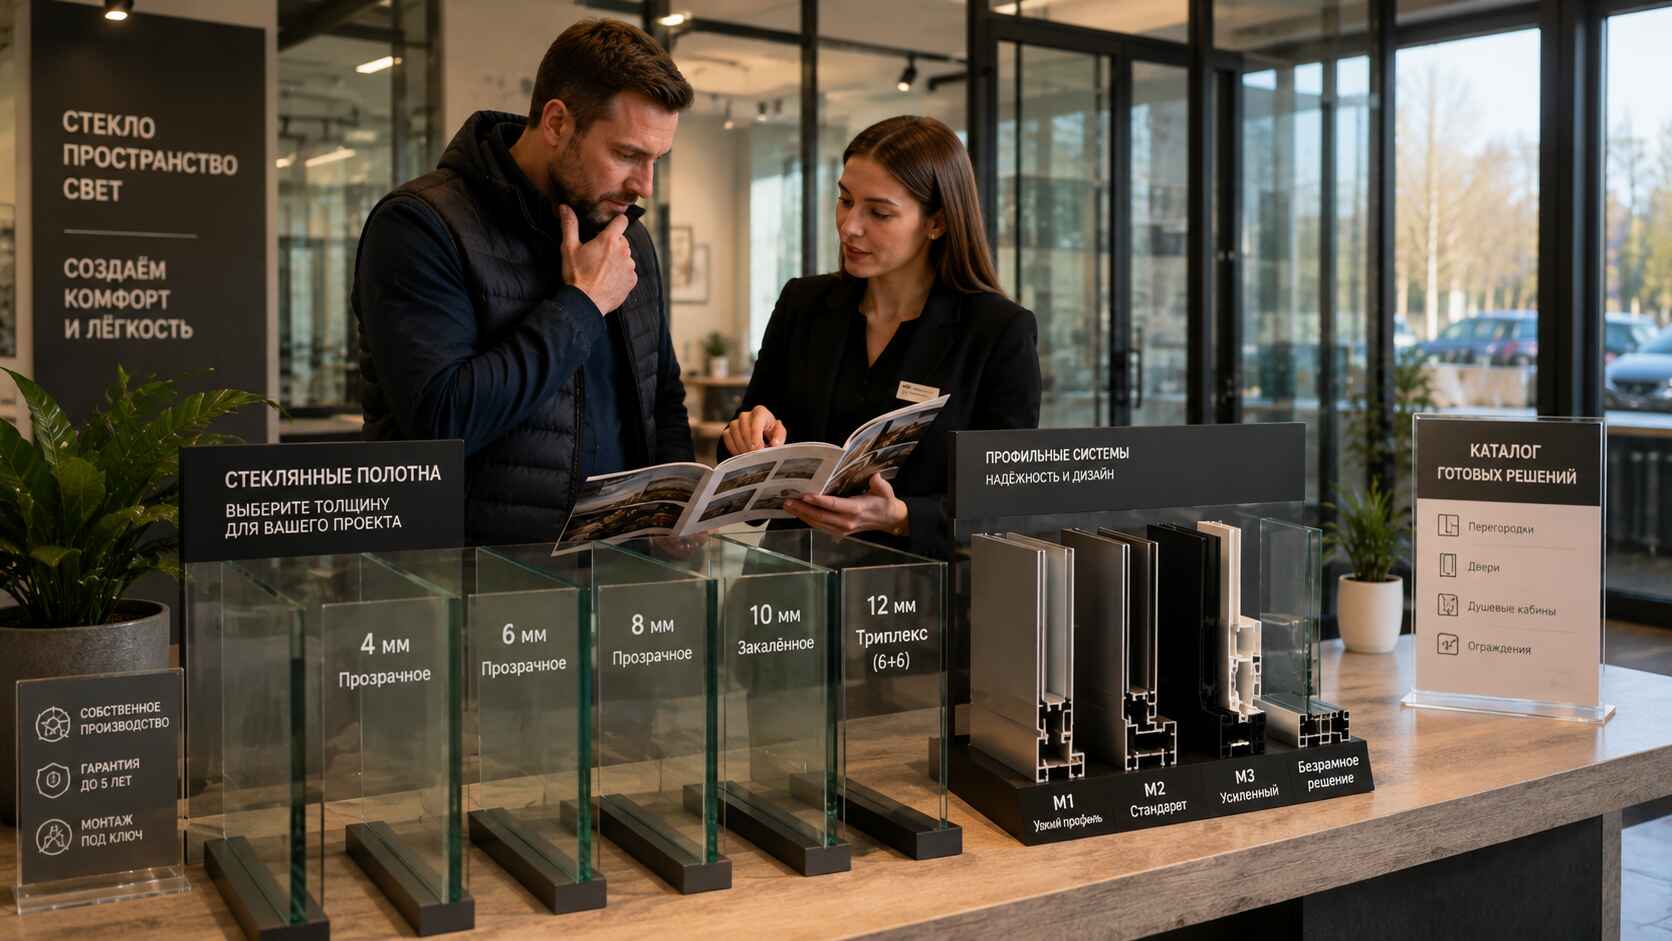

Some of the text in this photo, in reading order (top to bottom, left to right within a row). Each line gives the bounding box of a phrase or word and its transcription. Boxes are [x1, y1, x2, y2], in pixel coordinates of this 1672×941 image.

[62, 110, 156, 139] СТЕКЛО
[63, 144, 239, 176] ПРОСТРАНСТВО
[63, 177, 123, 202] СВЕТ
[64, 256, 167, 282] СОЗДАЁМ
[64, 288, 171, 310] КОМФОРТ
[65, 314, 194, 339] И ЛЁГКОСТЬ
[985, 446, 1130, 465] ПРОФИЛЬНЫЕ СИСТЕМЫ
[1470, 443, 1542, 460] КАТАЛОГ
[225, 464, 442, 489] СТЕКЛЯННЫЕ ПОЛОТНА
[985, 466, 1115, 487] НАДЁЖНОСТЬ И ДИЗАЙН
[1437, 466, 1577, 485] ГОТОВЫХ РЕШЕНИЙ
[225, 497, 390, 518] ВЫБЕРИТЕ ТОЛЩИНУ
[225, 515, 402, 540] ДЛЯ ВАШЕГО ПРОЕКТА
[1468, 521, 1535, 536] Перегородки
[1468, 561, 1500, 574] Двери
[750, 604, 801, 625] 10 мм
[867, 595, 916, 616] 12 мм
[1468, 601, 1557, 617] Душевые кабины
[502, 623, 547, 645] 6 мм
[631, 613, 674, 635] 8 мм
[360, 632, 410, 655] 4 мм
[737, 637, 815, 655] Закалённое
[856, 627, 928, 648] Триплекс
[1468, 641, 1532, 655] Ограждения
[481, 656, 567, 678] Прозрачное
[613, 648, 692, 669] Прозрачное
[873, 651, 911, 673] (6+6)
[339, 668, 431, 690] Прозрачное
[80, 701, 161, 719] СОБСТВЕННОЕ
[80, 717, 170, 736] ПРОИЗВОДСТВО
[81, 758, 140, 775] ГАРАНТИЯ
[1298, 755, 1360, 774] Безрамное
[80, 775, 132, 793] ДО 5 ЛЕТ
[1307, 773, 1355, 792] решение
[1219, 783, 1279, 804] Усиленный
[81, 814, 133, 831] МОНТАЖ
[81, 830, 143, 848] ПОД КЛЮЧ
